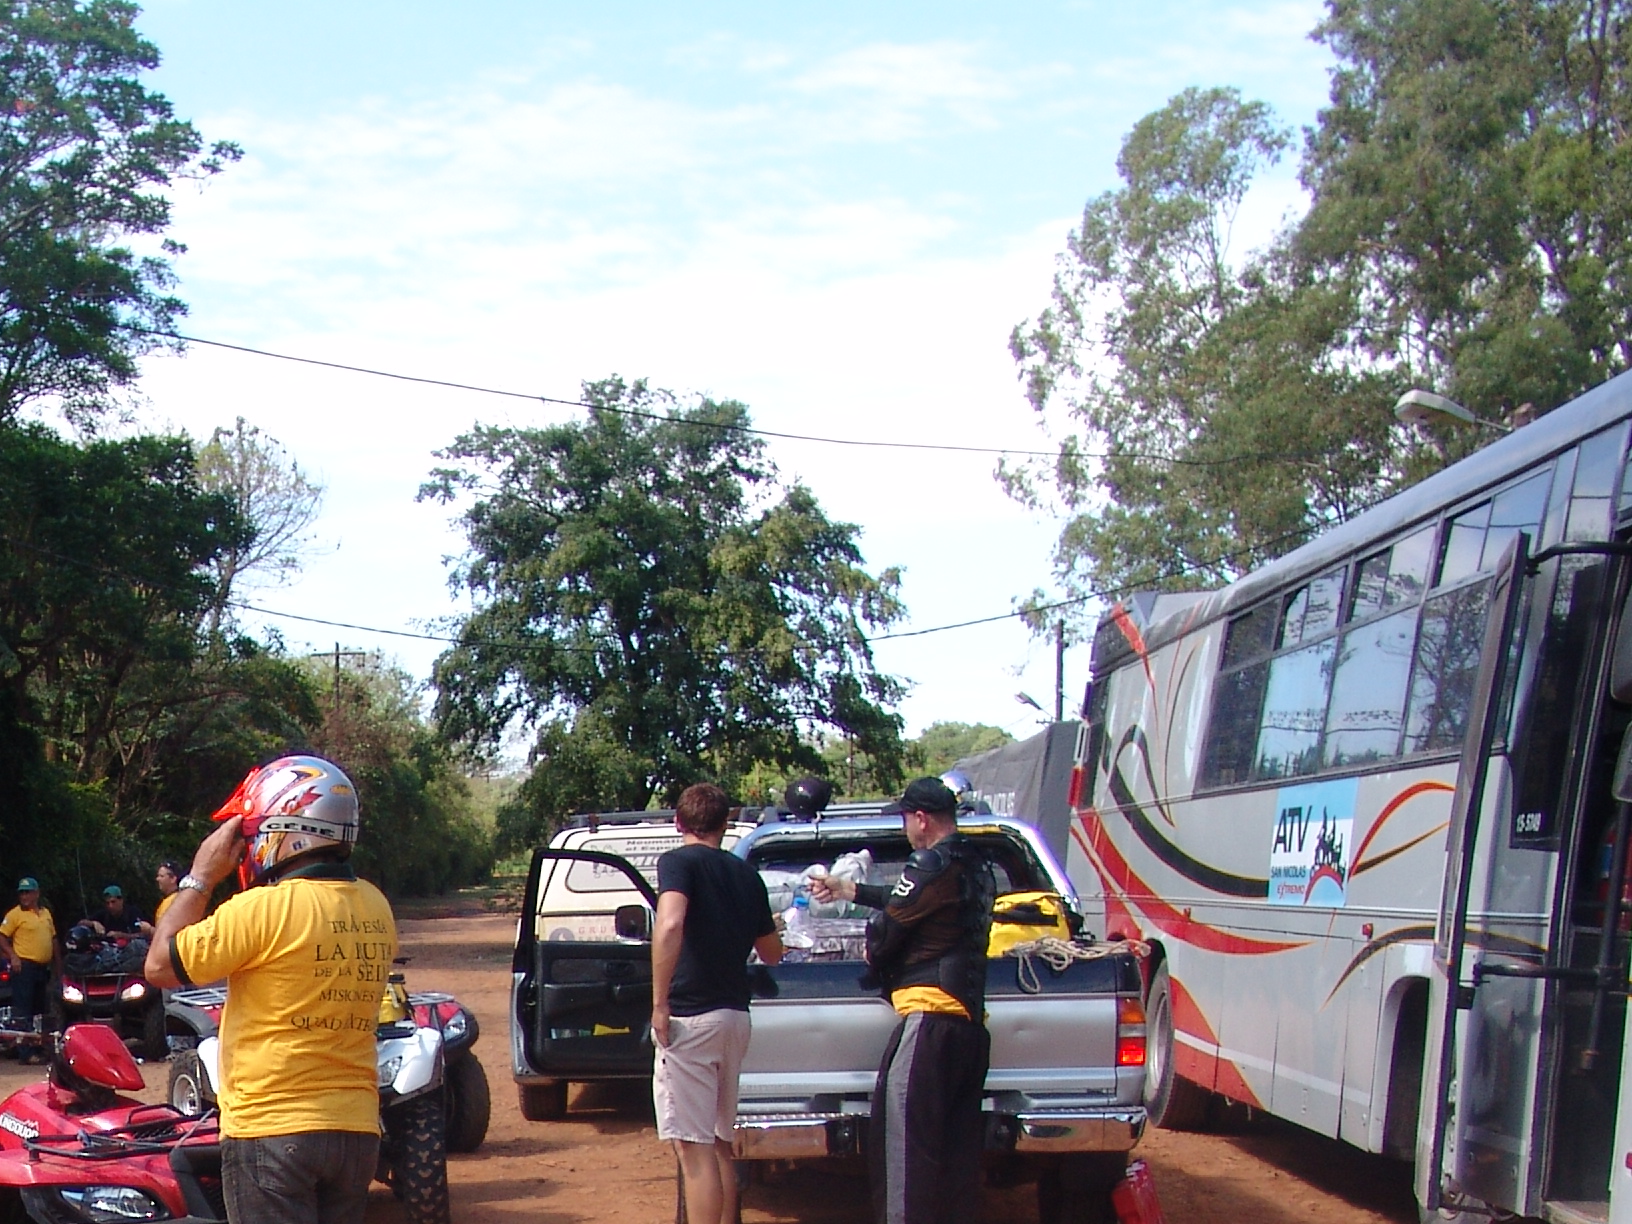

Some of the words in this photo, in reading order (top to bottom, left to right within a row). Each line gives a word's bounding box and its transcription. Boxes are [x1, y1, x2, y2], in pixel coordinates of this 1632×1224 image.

[1272, 805, 1313, 854] ATV
[1271, 865, 1282, 879] SAN
[314, 943, 348, 962] LA
[314, 967, 332, 978] DE
[338, 966, 352, 976] LA
